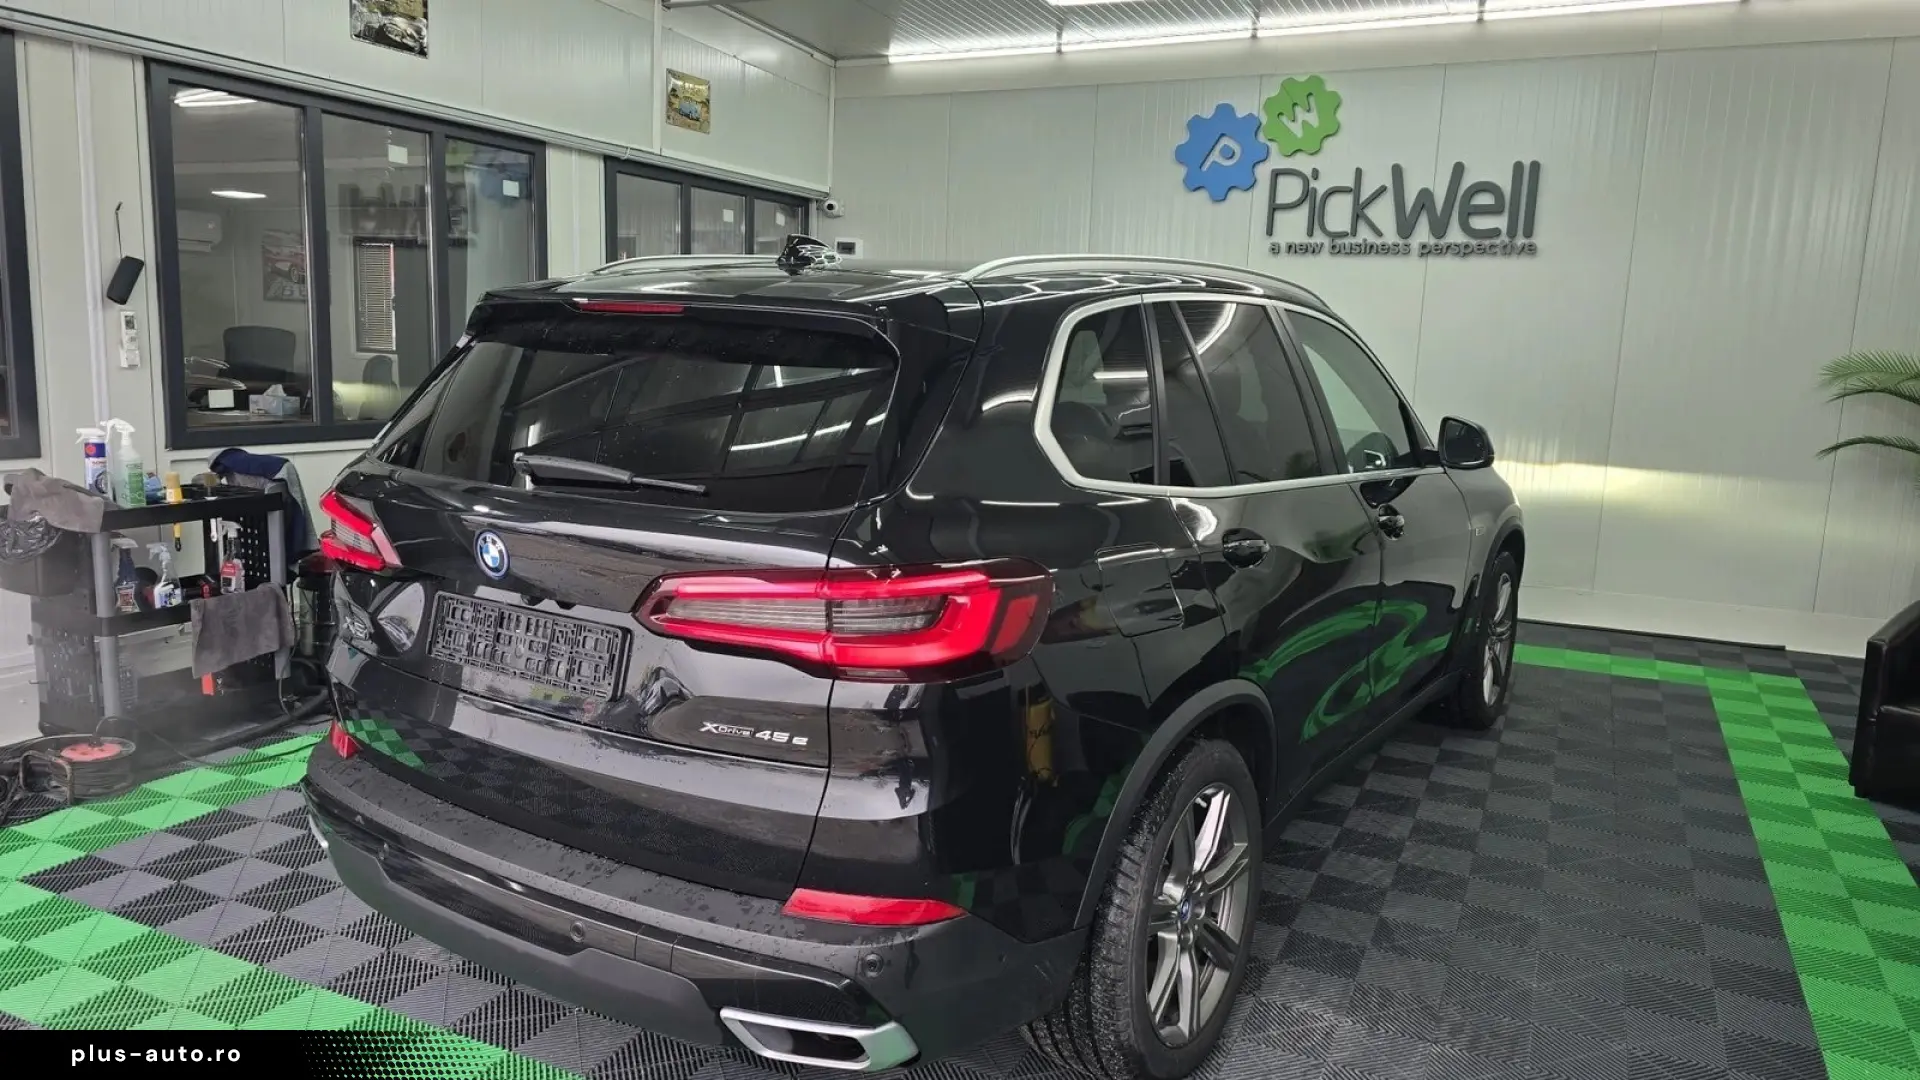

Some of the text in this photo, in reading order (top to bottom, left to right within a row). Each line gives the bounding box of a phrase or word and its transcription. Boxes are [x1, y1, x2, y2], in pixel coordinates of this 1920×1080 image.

[1266, 160, 1541, 239] PickWell
[1268, 237, 1538, 258] a new business perspective
